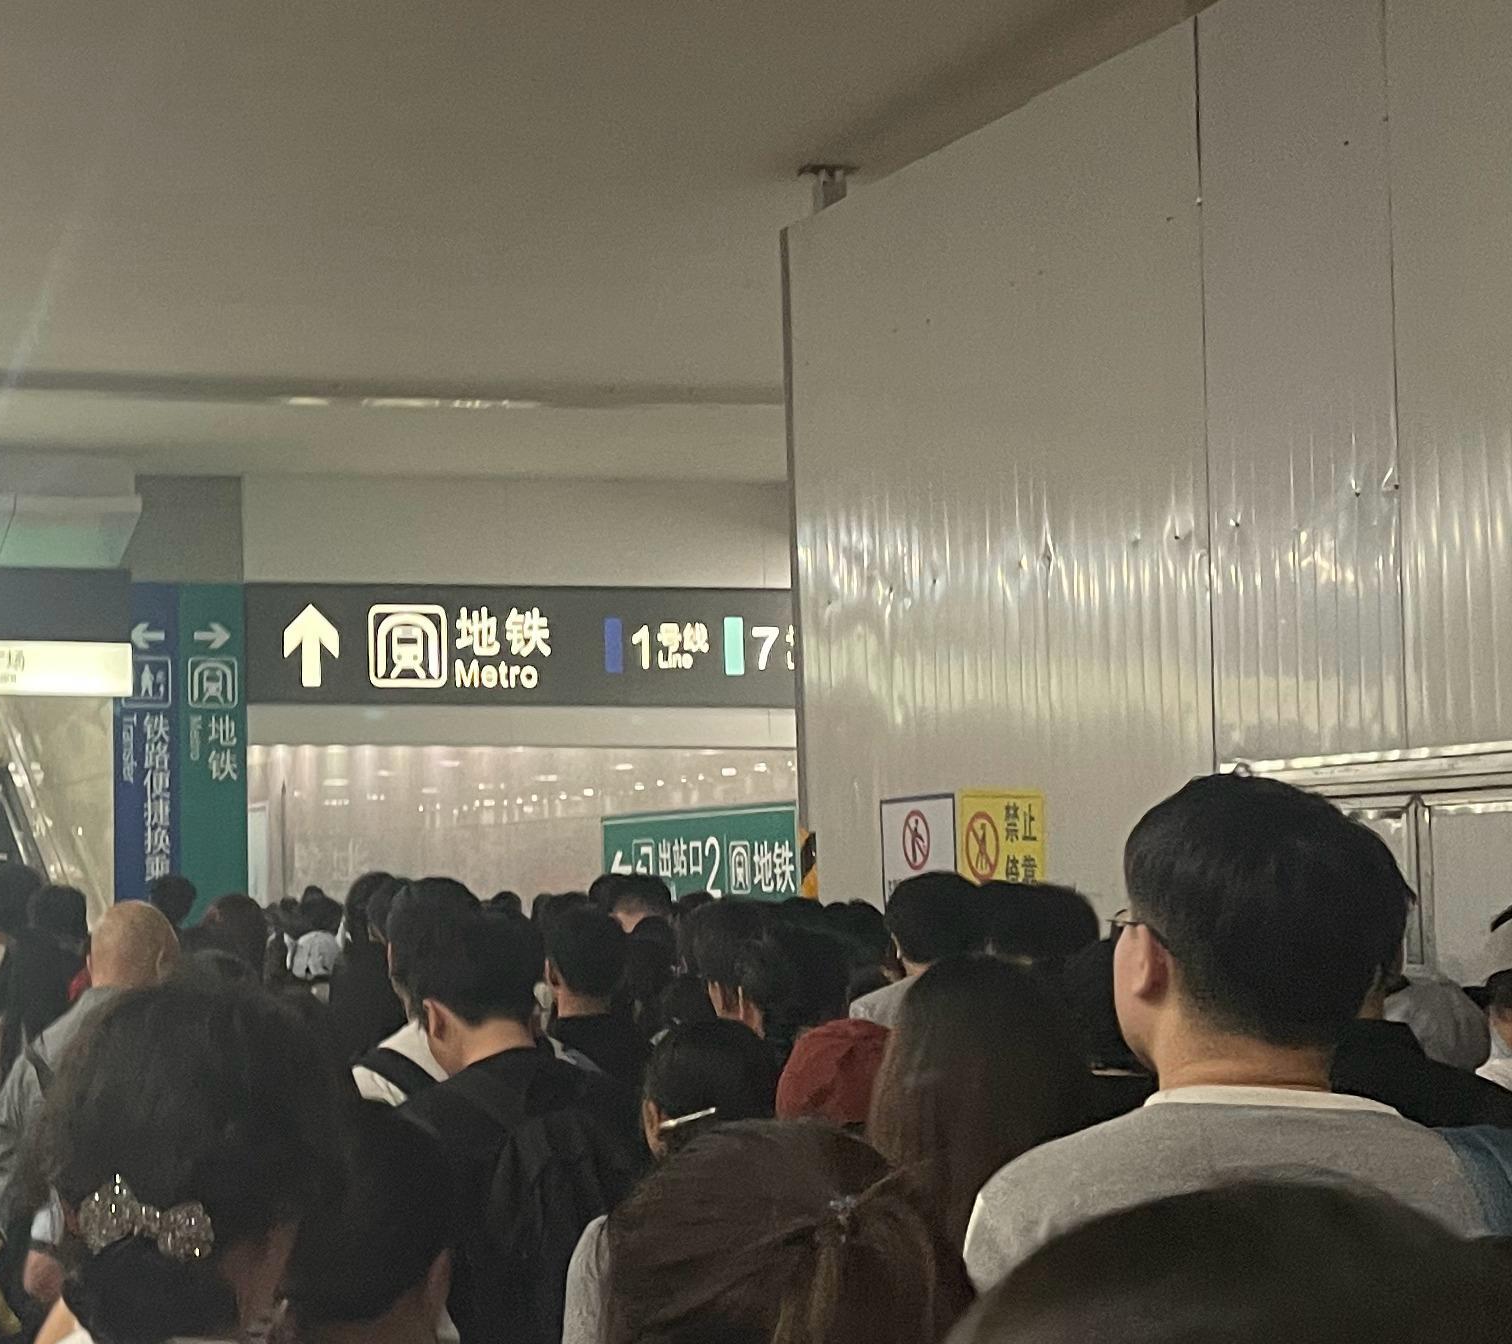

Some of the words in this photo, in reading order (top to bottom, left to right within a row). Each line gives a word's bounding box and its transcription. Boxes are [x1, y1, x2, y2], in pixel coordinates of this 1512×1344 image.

[455, 605, 552, 658] 地铁
[454, 658, 539, 689] Metro
[657, 649, 694, 669] Line
[207, 714, 238, 782] 地铁
[143, 711, 171, 882] 铁路便捷换乘
[1004, 802, 1038, 843] 禁止
[752, 840, 797, 893] 地铁
